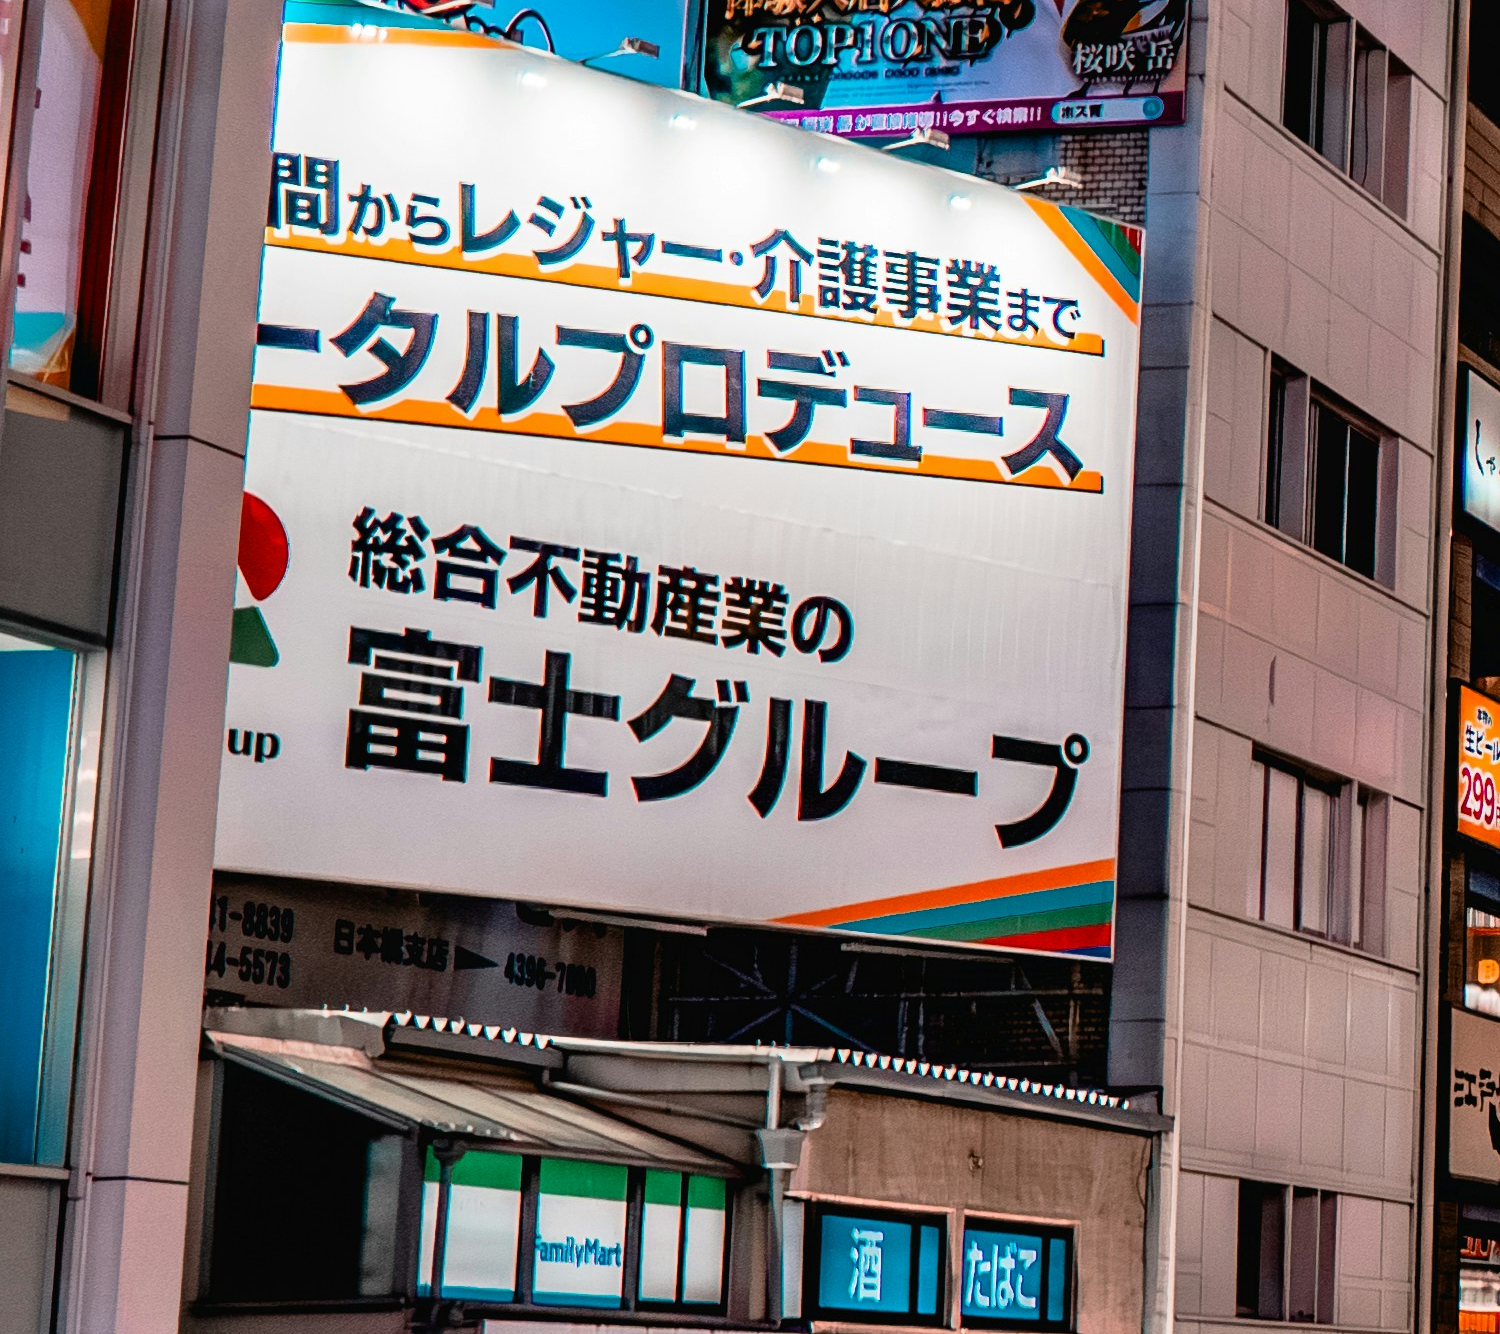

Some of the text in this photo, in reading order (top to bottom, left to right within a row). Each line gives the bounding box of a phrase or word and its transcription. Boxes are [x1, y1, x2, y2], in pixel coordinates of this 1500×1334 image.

[346, 505, 856, 666] 総合不動産業の
[343, 621, 1092, 851] 富士グループ
[848, 1226, 885, 1304] 酒
[963, 1240, 1039, 1312] たばこ
